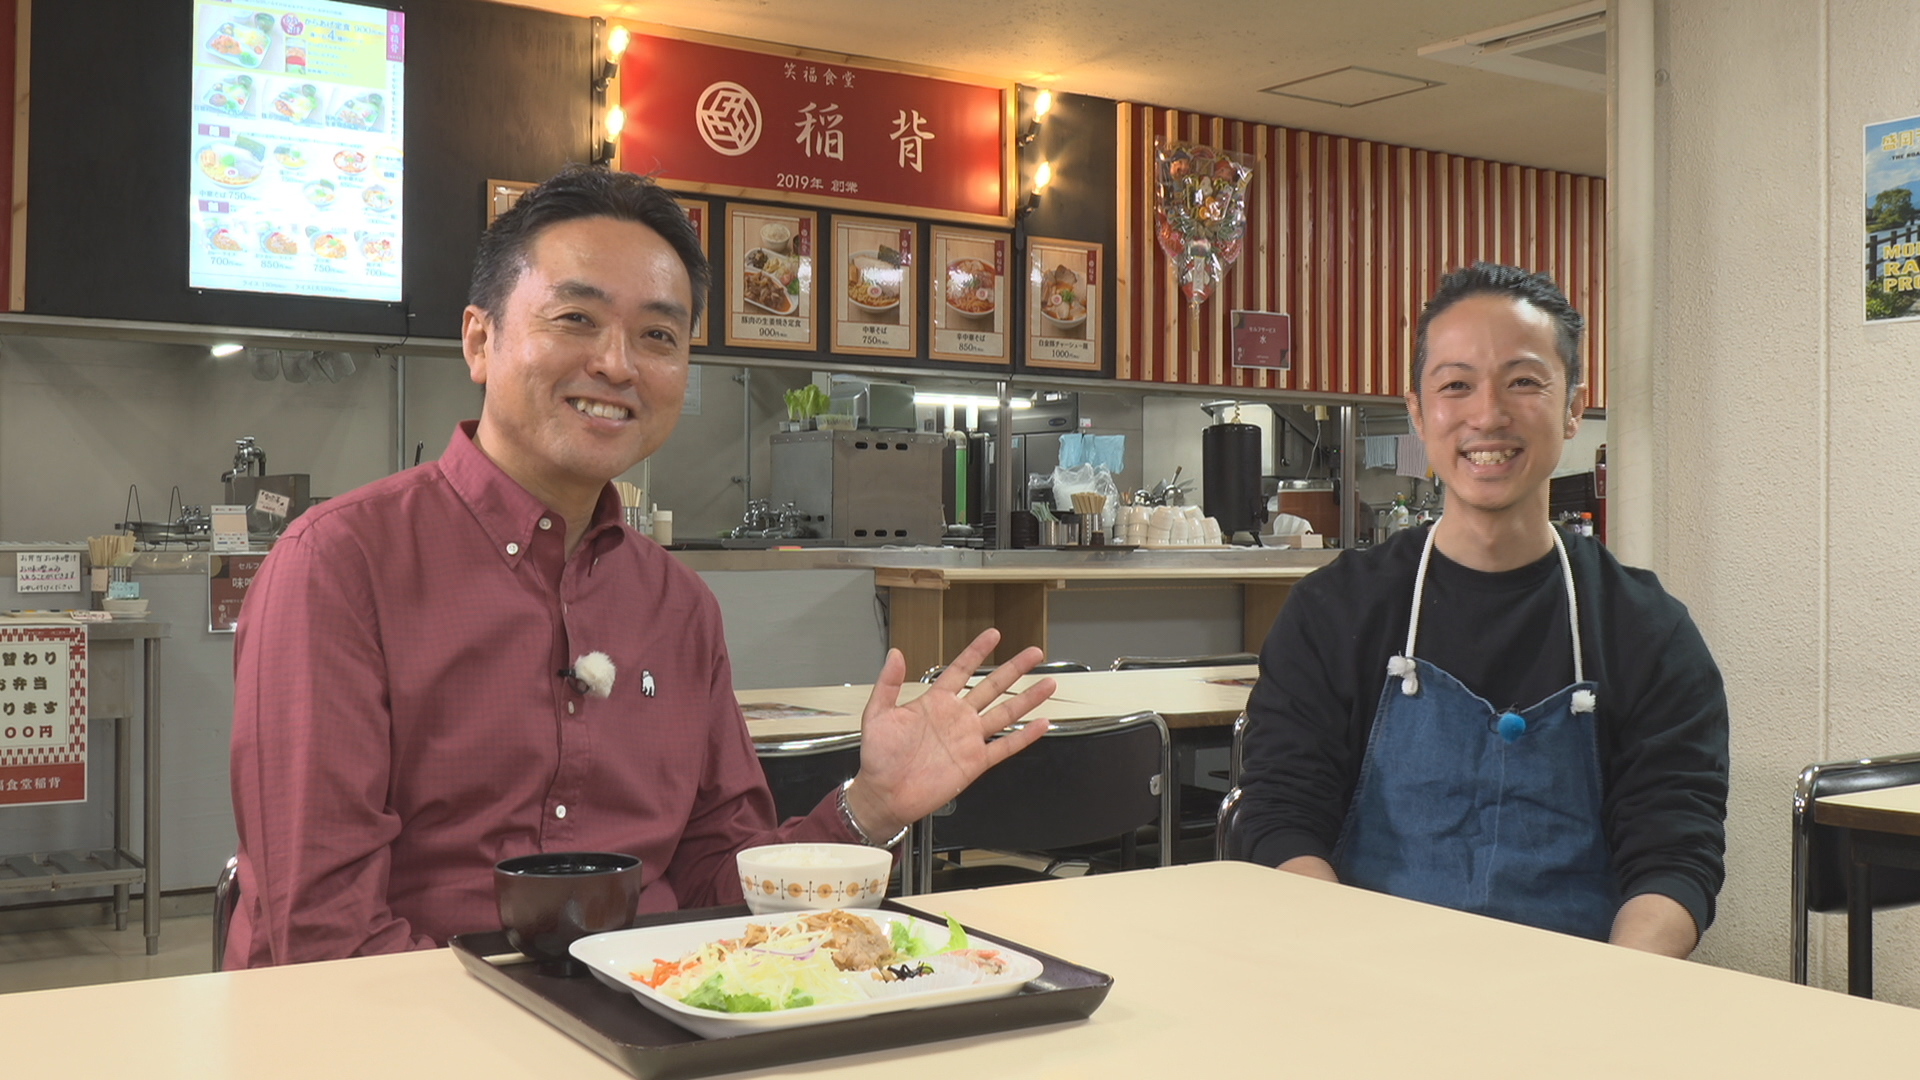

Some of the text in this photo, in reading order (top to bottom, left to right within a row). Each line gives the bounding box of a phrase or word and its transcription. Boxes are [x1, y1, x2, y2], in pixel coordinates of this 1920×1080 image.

[784, 62, 856, 89] 笑福食堂
[794, 101, 935, 173] 稲背
[776, 172, 858, 194] 2019年 創業
[862, 325, 888, 335] 中華そば
[1259, 334, 1267, 345] 水
[2, 651, 57, 667] 替わり
[3, 700, 59, 717] ります
